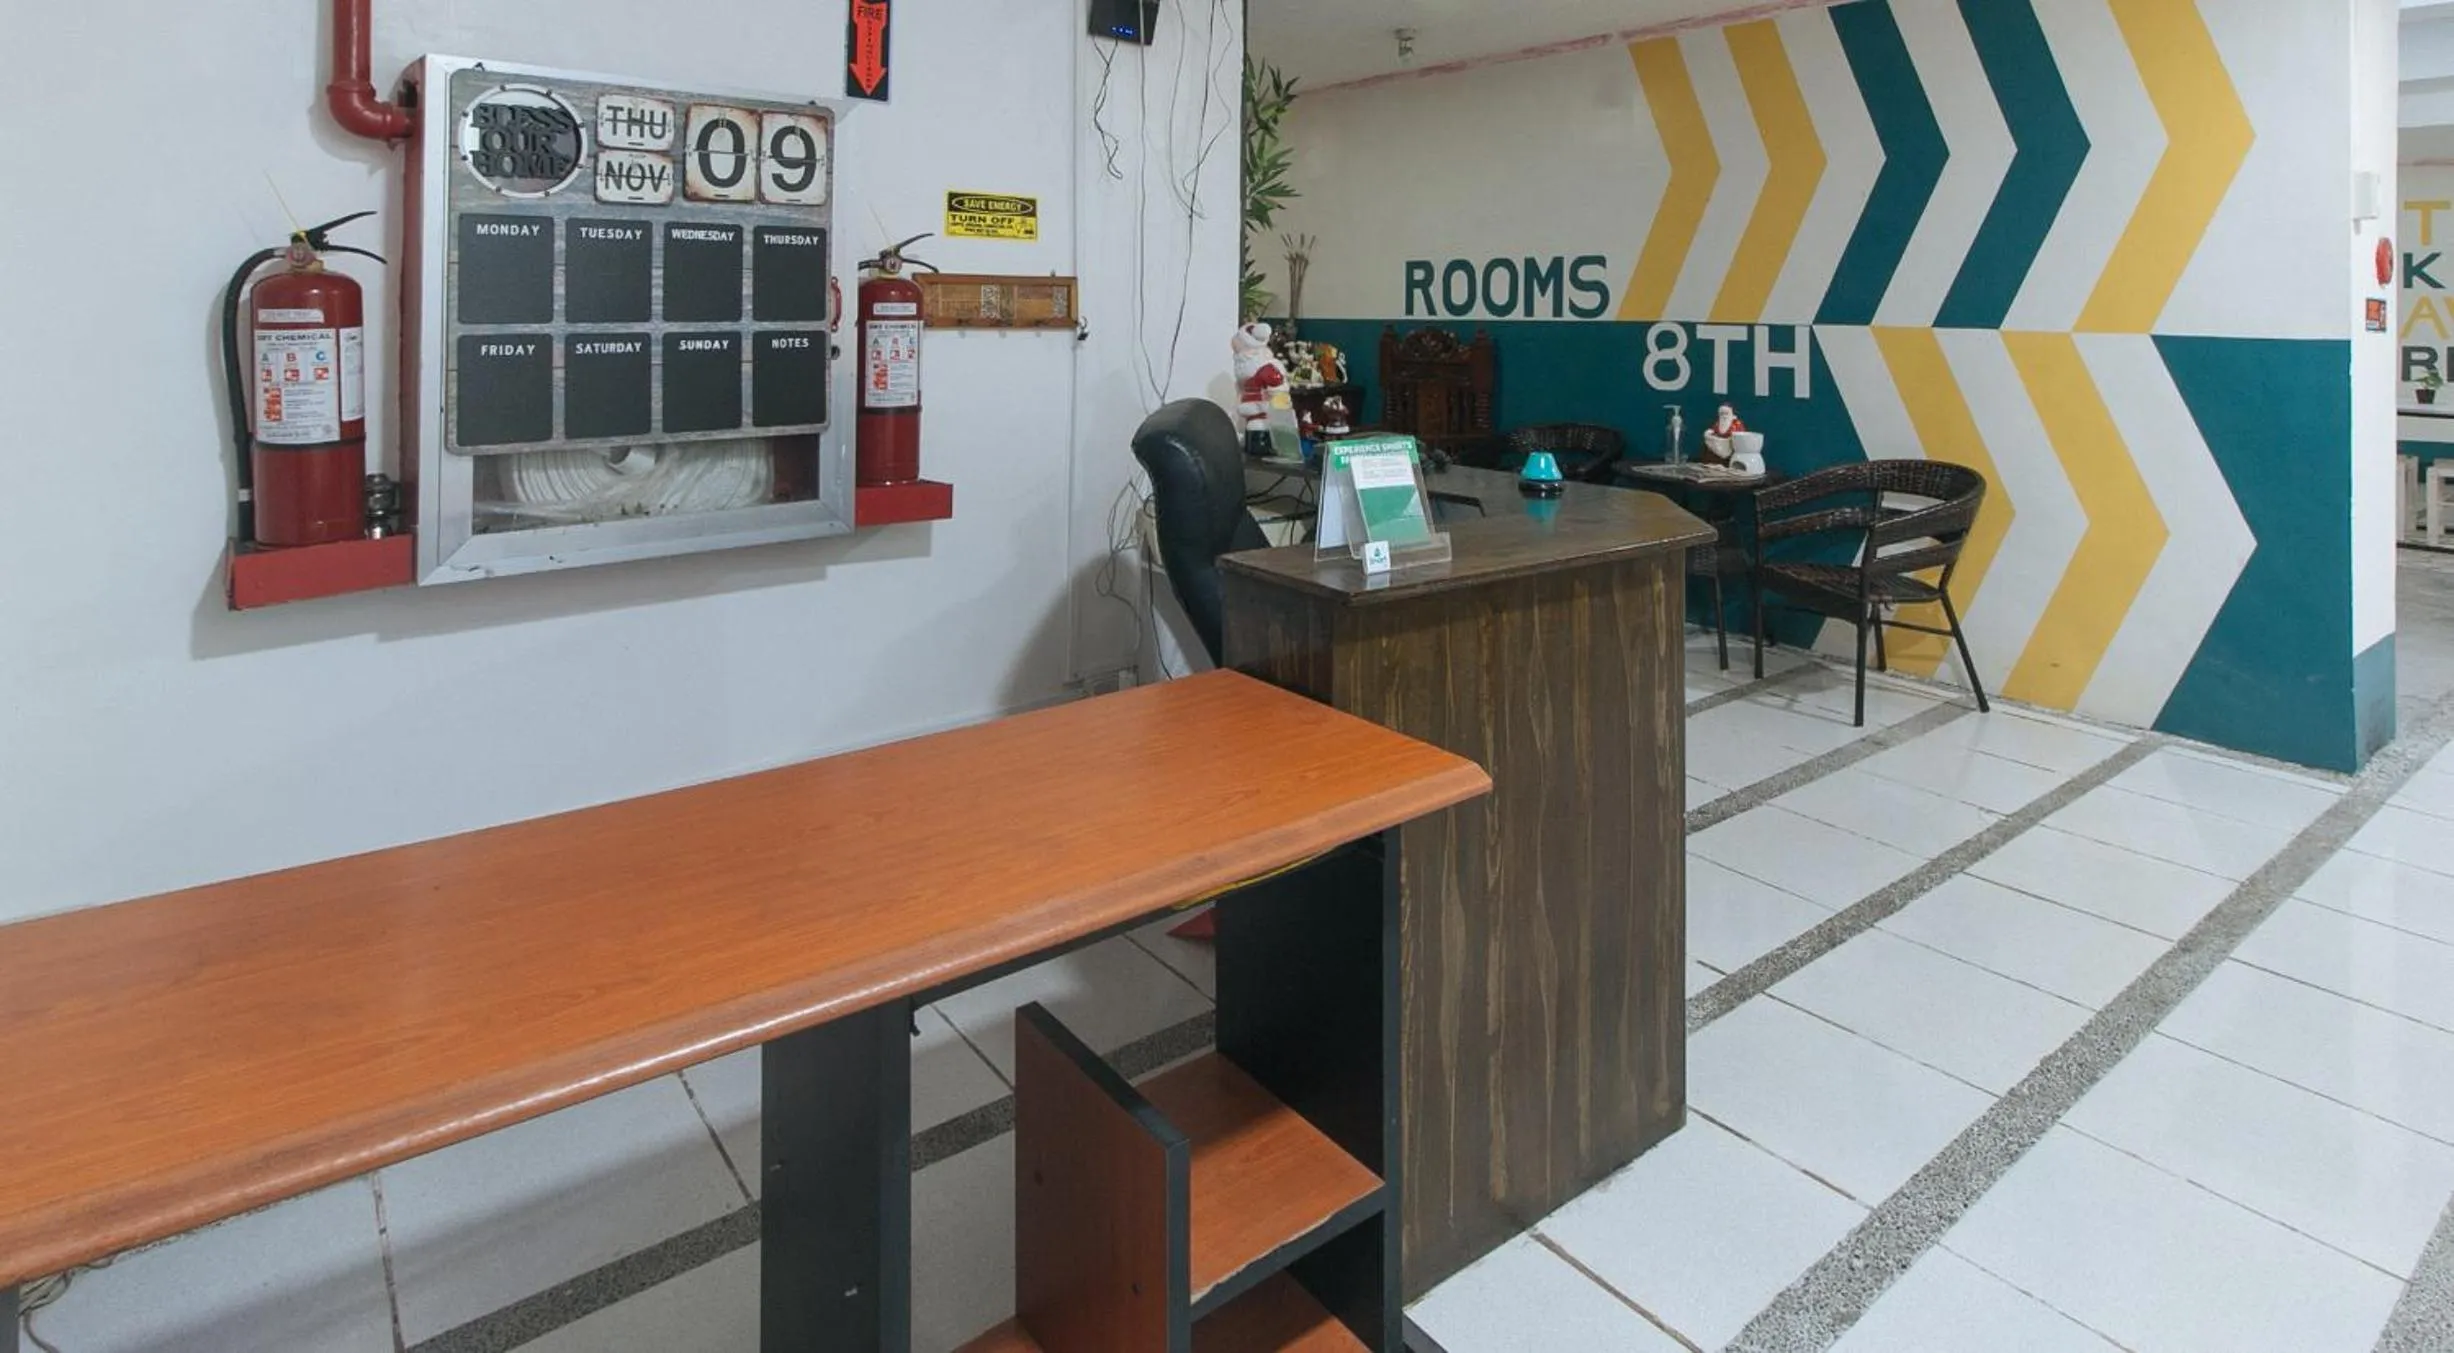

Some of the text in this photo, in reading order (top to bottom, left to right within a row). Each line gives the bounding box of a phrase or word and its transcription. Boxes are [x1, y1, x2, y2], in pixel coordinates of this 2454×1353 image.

[606, 104, 668, 139] THU
[604, 160, 668, 194] NOV
[963, 198, 1022, 212] SAVE ENERGY
[950, 213, 1014, 224] TURN OFF
[476, 224, 540, 236] MONDAY
[580, 227, 643, 240] TUESDAY
[671, 229, 735, 241] WEDNESDAY
[763, 234, 819, 246] THURSDAY
[1404, 255, 1610, 319] ROOMS
[275, 333, 332, 342] CHEMICAL
[771, 338, 809, 348] NOTES
[480, 344, 536, 356] FRIDAY
[575, 342, 642, 354] SATURDAY
[678, 339, 729, 350] SUNDAY
[316, 351, 327, 361] C
[1642, 321, 1811, 399] 8TH
